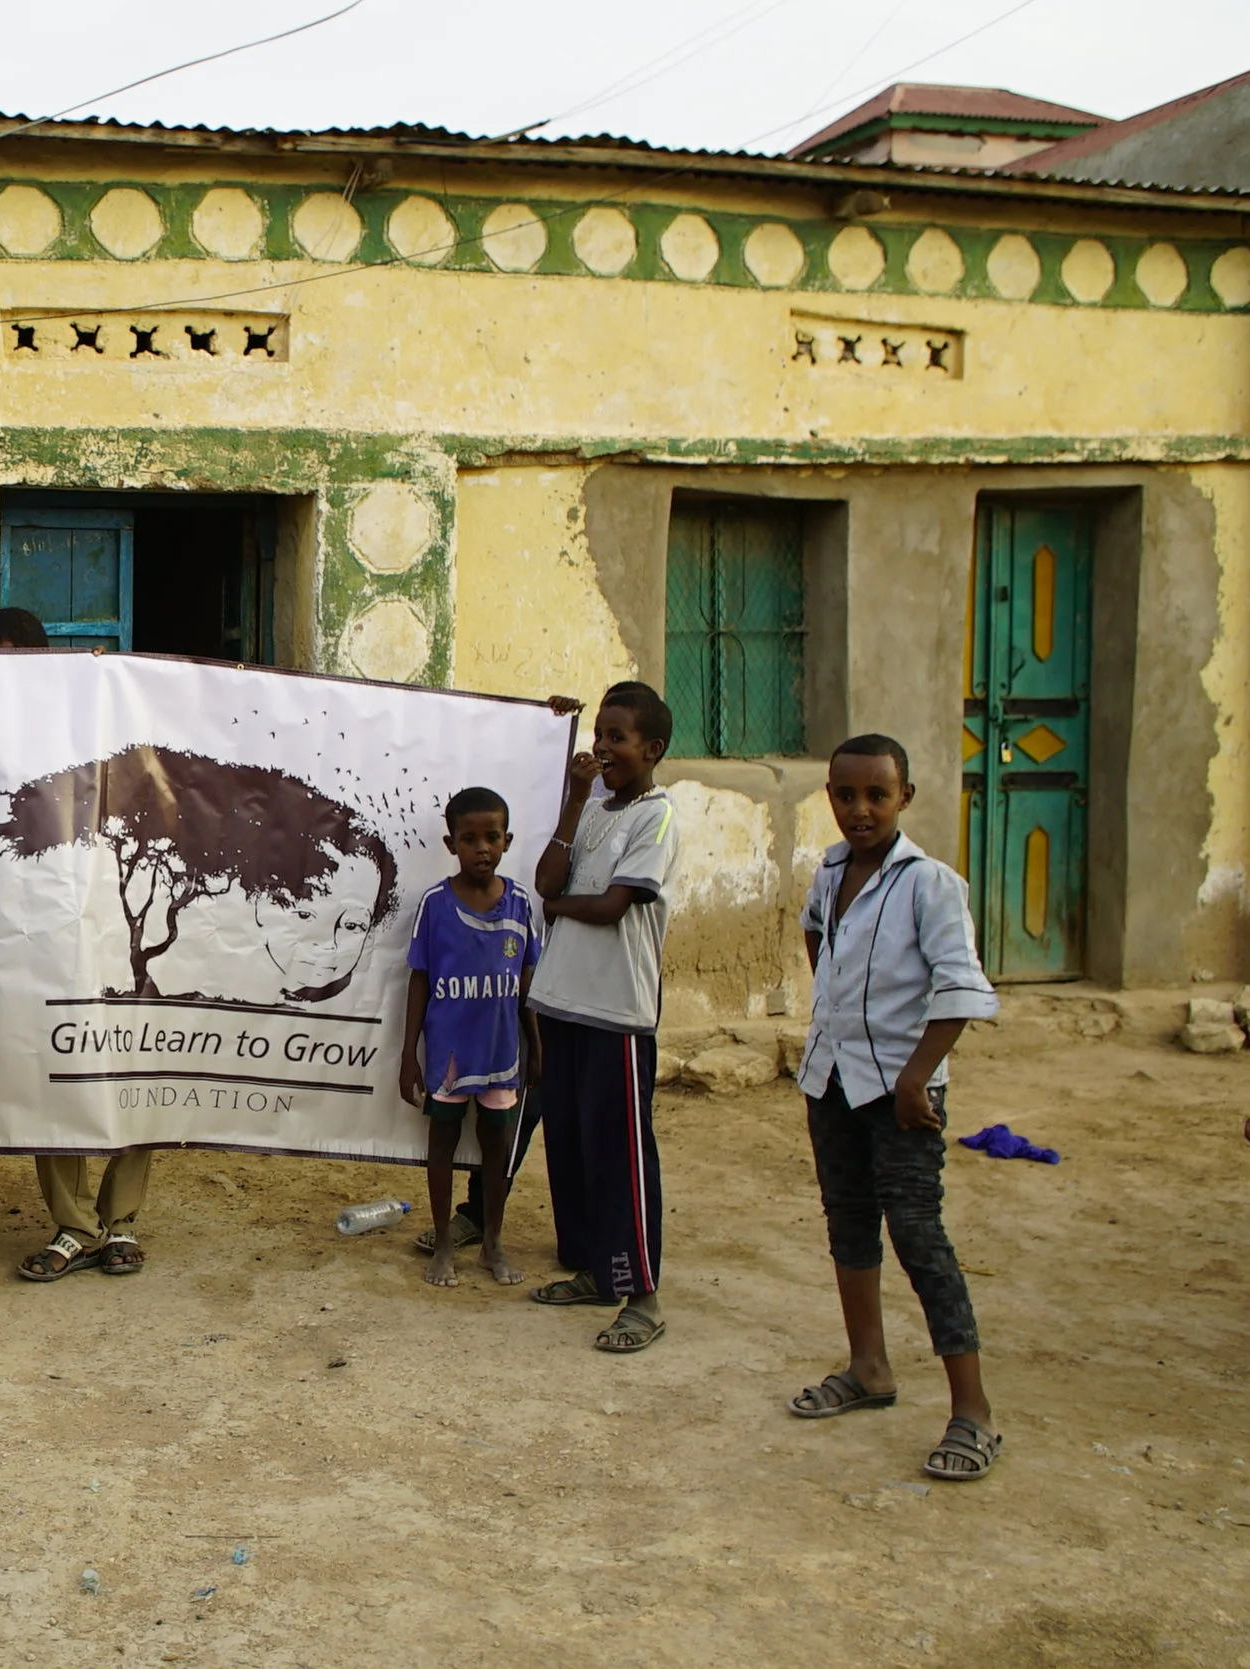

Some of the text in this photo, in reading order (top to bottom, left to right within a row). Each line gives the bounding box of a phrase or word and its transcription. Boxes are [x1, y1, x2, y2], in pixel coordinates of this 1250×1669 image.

[51, 1021, 378, 1067] Giv to Learn to Grow
[118, 1086, 294, 1113] OUNDATION
